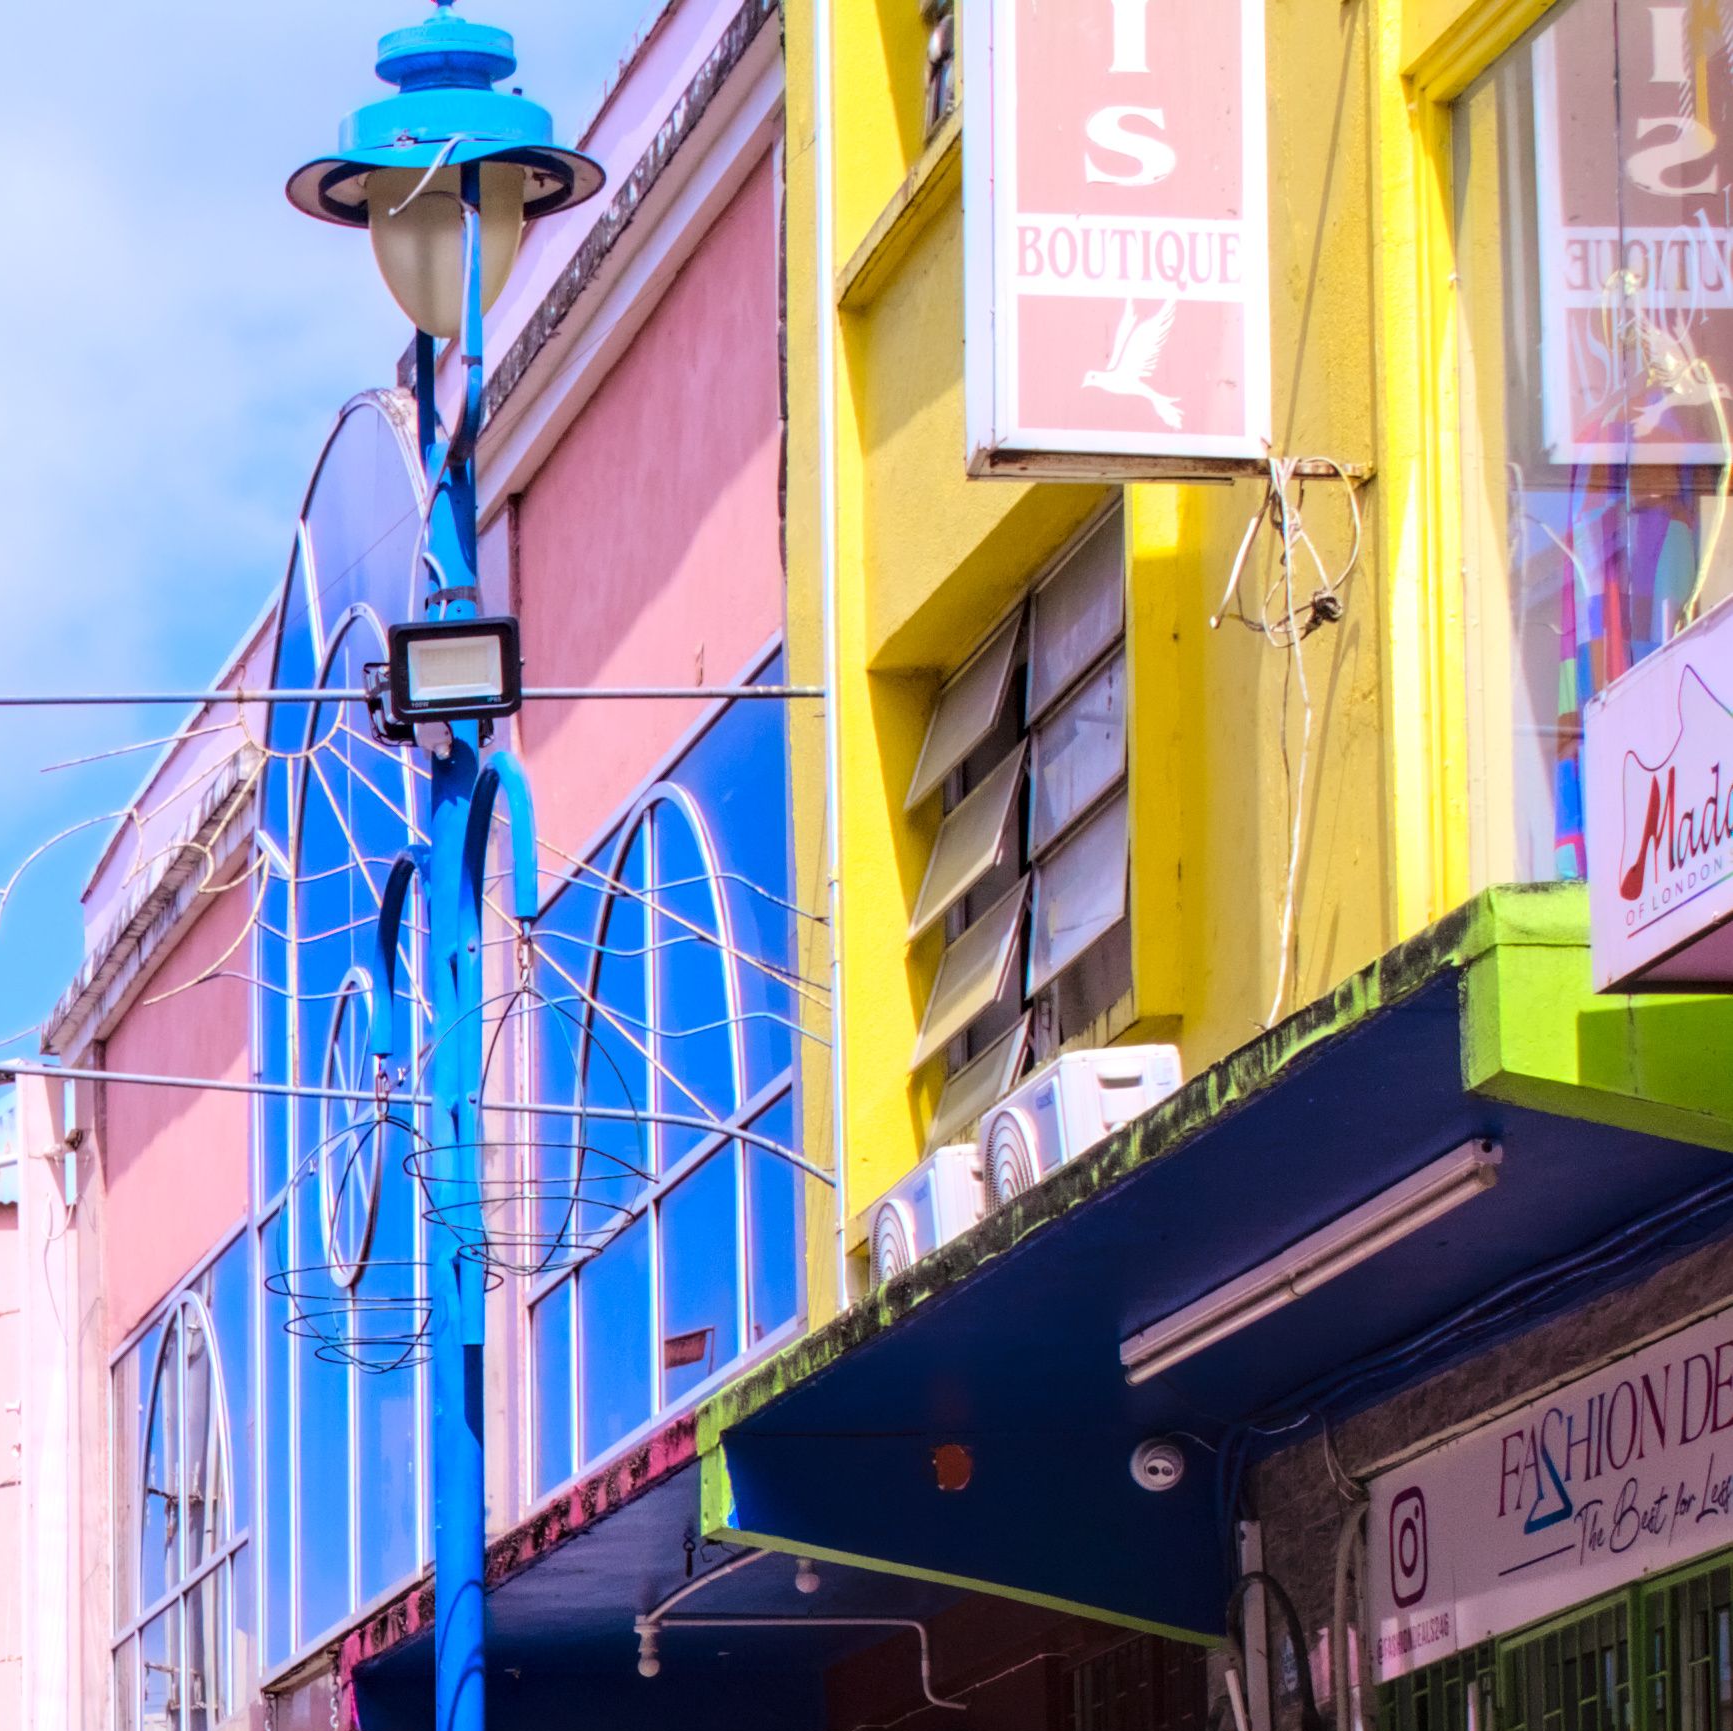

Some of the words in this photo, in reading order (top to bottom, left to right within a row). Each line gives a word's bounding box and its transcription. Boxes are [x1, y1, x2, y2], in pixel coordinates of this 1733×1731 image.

[1015, 224, 1241, 291] BOUTIQUE
[1626, 903, 1645, 926] OF
[1653, 855, 1724, 912] LONDON
[1497, 1363, 1672, 1536] FASHION
[1574, 1498, 1604, 1567] The
[1609, 1476, 1669, 1554] Best
